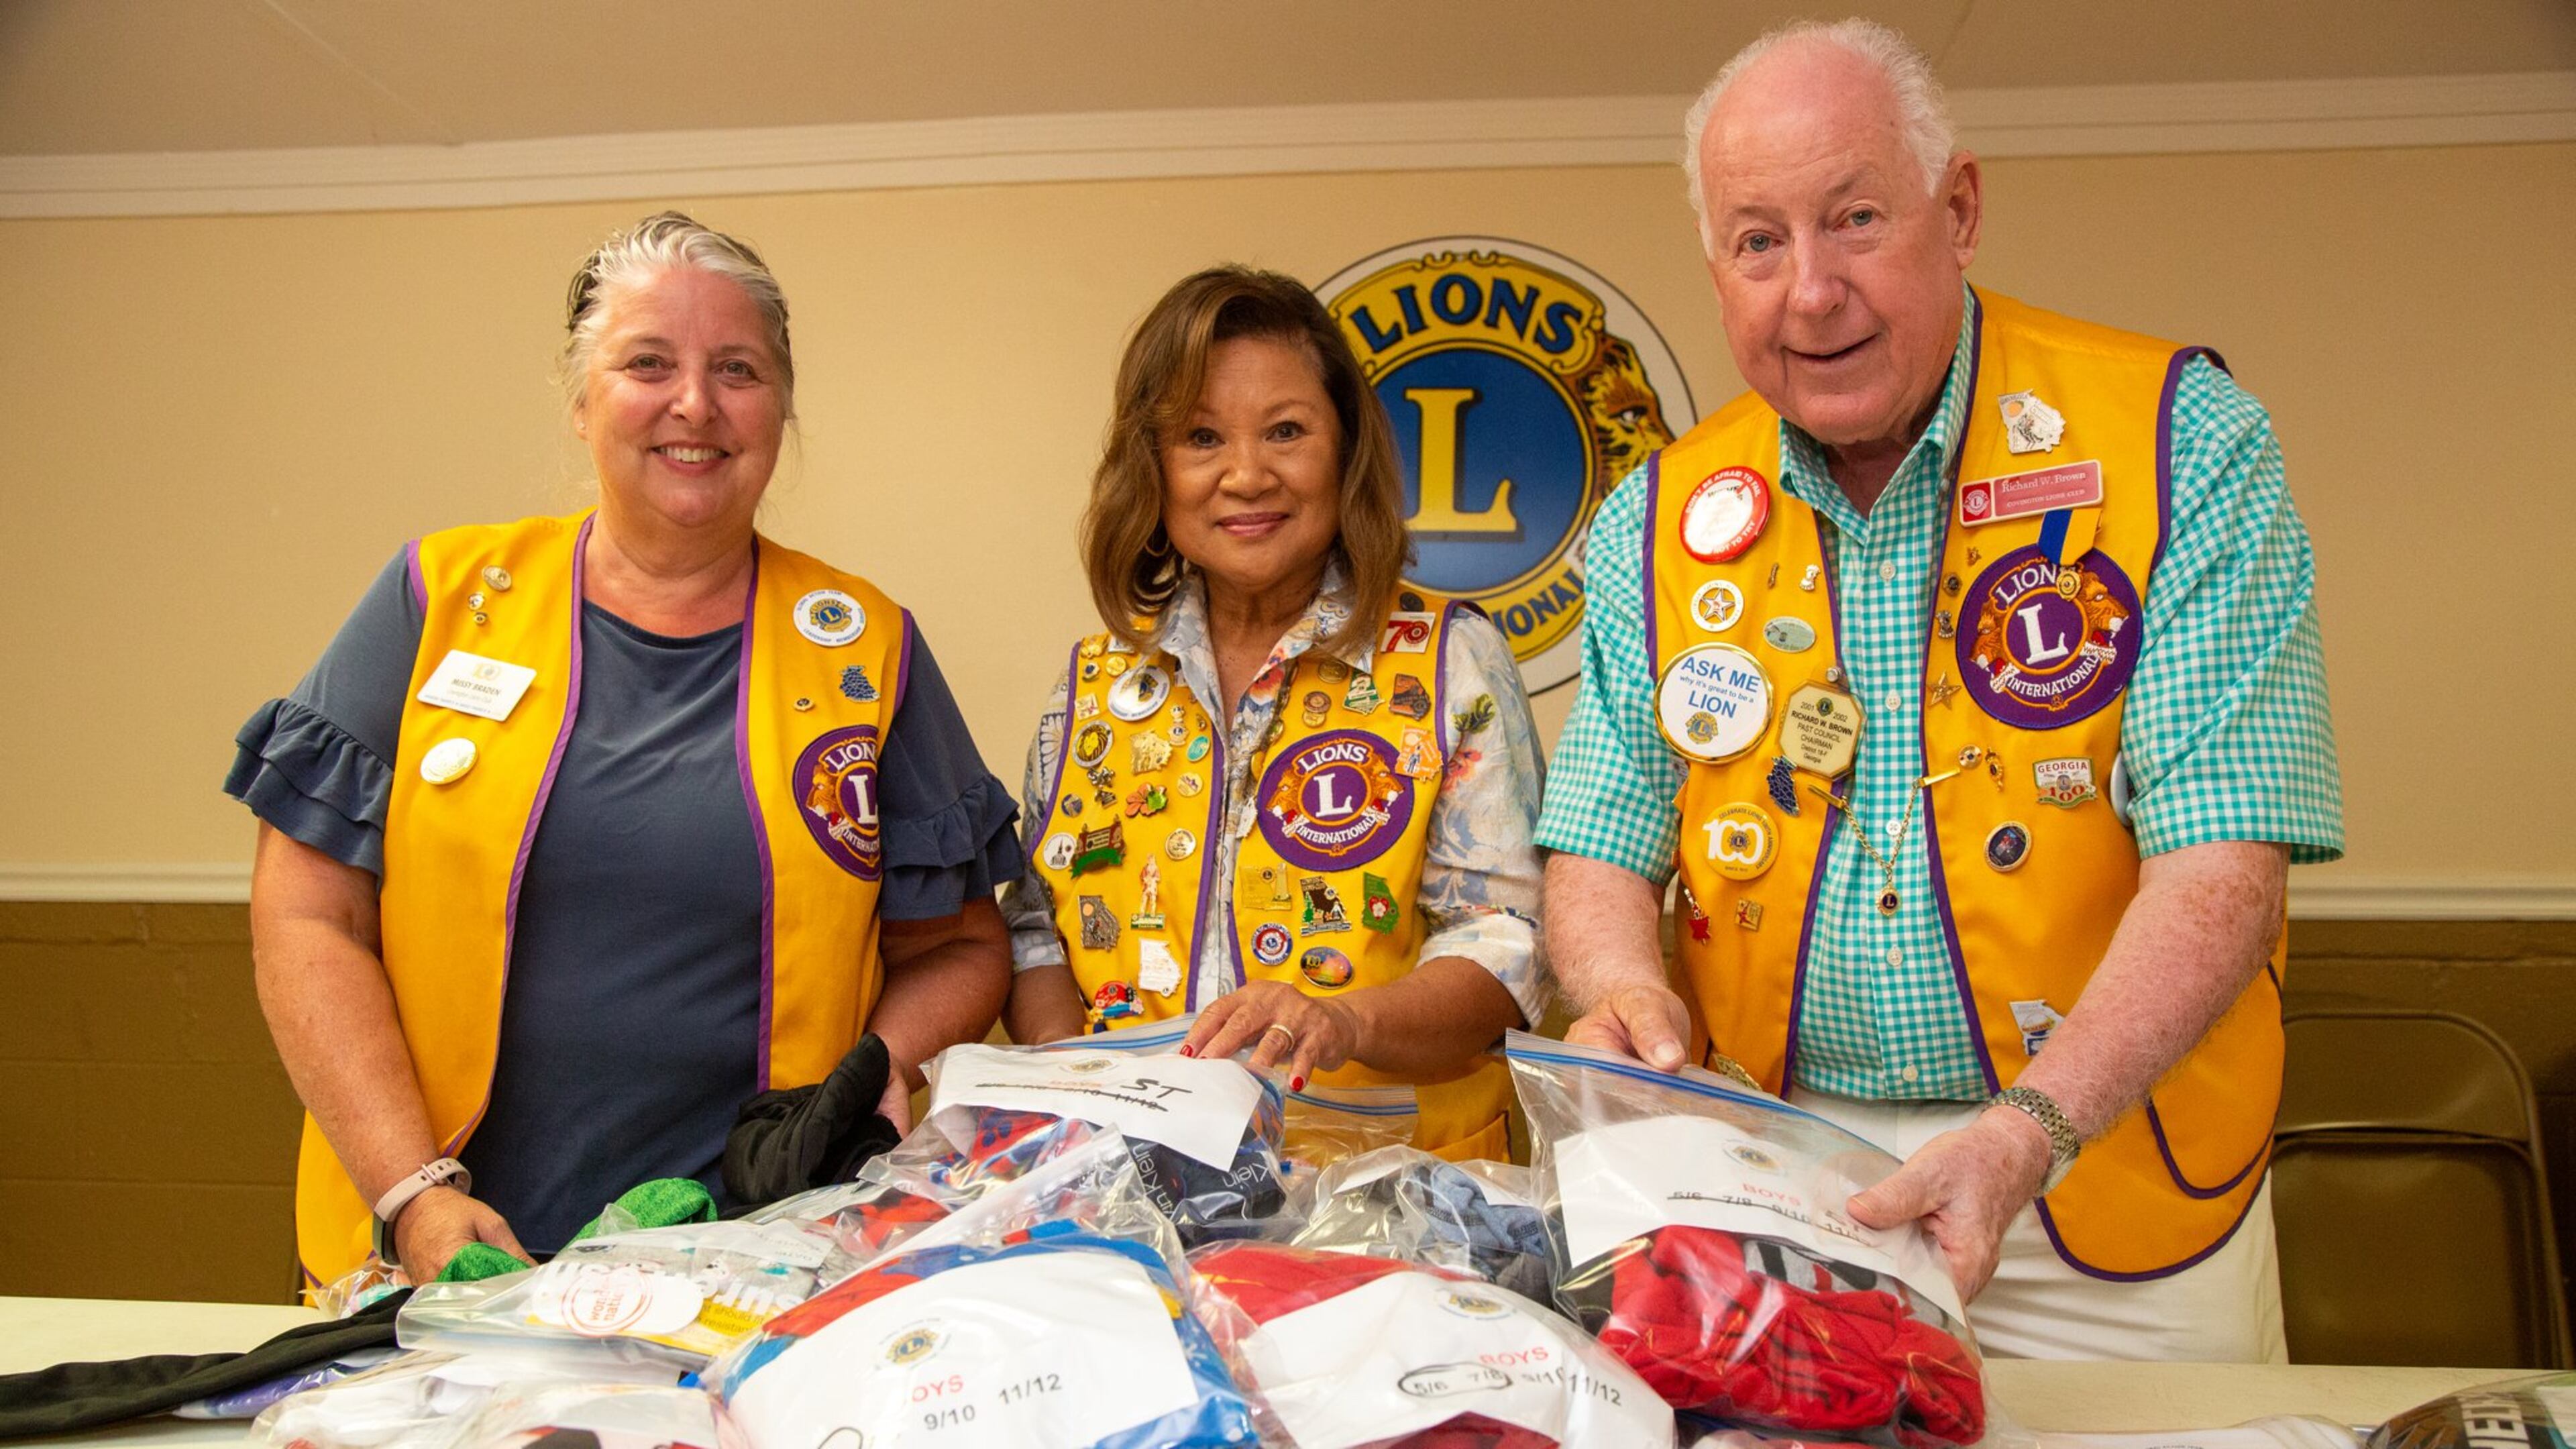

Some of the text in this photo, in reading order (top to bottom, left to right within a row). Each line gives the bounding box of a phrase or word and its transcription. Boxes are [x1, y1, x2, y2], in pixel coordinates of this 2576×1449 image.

[1348, 274, 1582, 354] LIONS
[1405, 387, 1517, 531] L
[1702, 478, 1713, 489] BE
[1714, 470, 1743, 482] AFRAID
[1743, 472, 1753, 482] TO
[1750, 480, 1762, 498] FAIL
[2002, 478, 2039, 493] Richard
[2055, 471, 2086, 484] Brown
[1996, 564, 2057, 604] LION
[2017, 603, 2070, 665] L
[1680, 675, 1694, 685] why
[1696, 680, 1707, 688] it's
[1708, 684, 1728, 695] great
[1729, 690, 1737, 698] to
[1738, 693, 1748, 702] be
[1681, 656, 1761, 693] ASK ME
[2006, 654, 2100, 698] INTERNATIONAL
[1688, 690, 1737, 718] LION
[1791, 710, 1819, 725] RICHARD
[1828, 722, 1853, 736] BROWN
[1798, 722, 1841, 743] PAST COUNCIL
[1801, 733, 1833, 750] CHAIRMAN
[824, 743, 877, 771] LION
[1298, 743, 1367, 772] LIONS
[2037, 761, 2088, 773] GEORGIA
[847, 773, 879, 824] L
[1313, 773, 1354, 818] L
[2049, 784, 2086, 802] 100
[1719, 807, 1747, 819] CELEBRATE
[1296, 816, 1377, 845] INTERNATIONAL
[1702, 818, 1764, 865] 100
[1885, 896, 1894, 907] L
[1222, 1162, 1269, 1190] Klein
[1742, 1183, 1801, 1207] BOYS
[1479, 1346, 1549, 1366] BOYS
[912, 1374, 964, 1402] OYS
[924, 1373, 1063, 1430] 9/10 11/12
[1413, 1381, 1448, 1396] 5/6
[1568, 1375, 1621, 1407] 11/12
